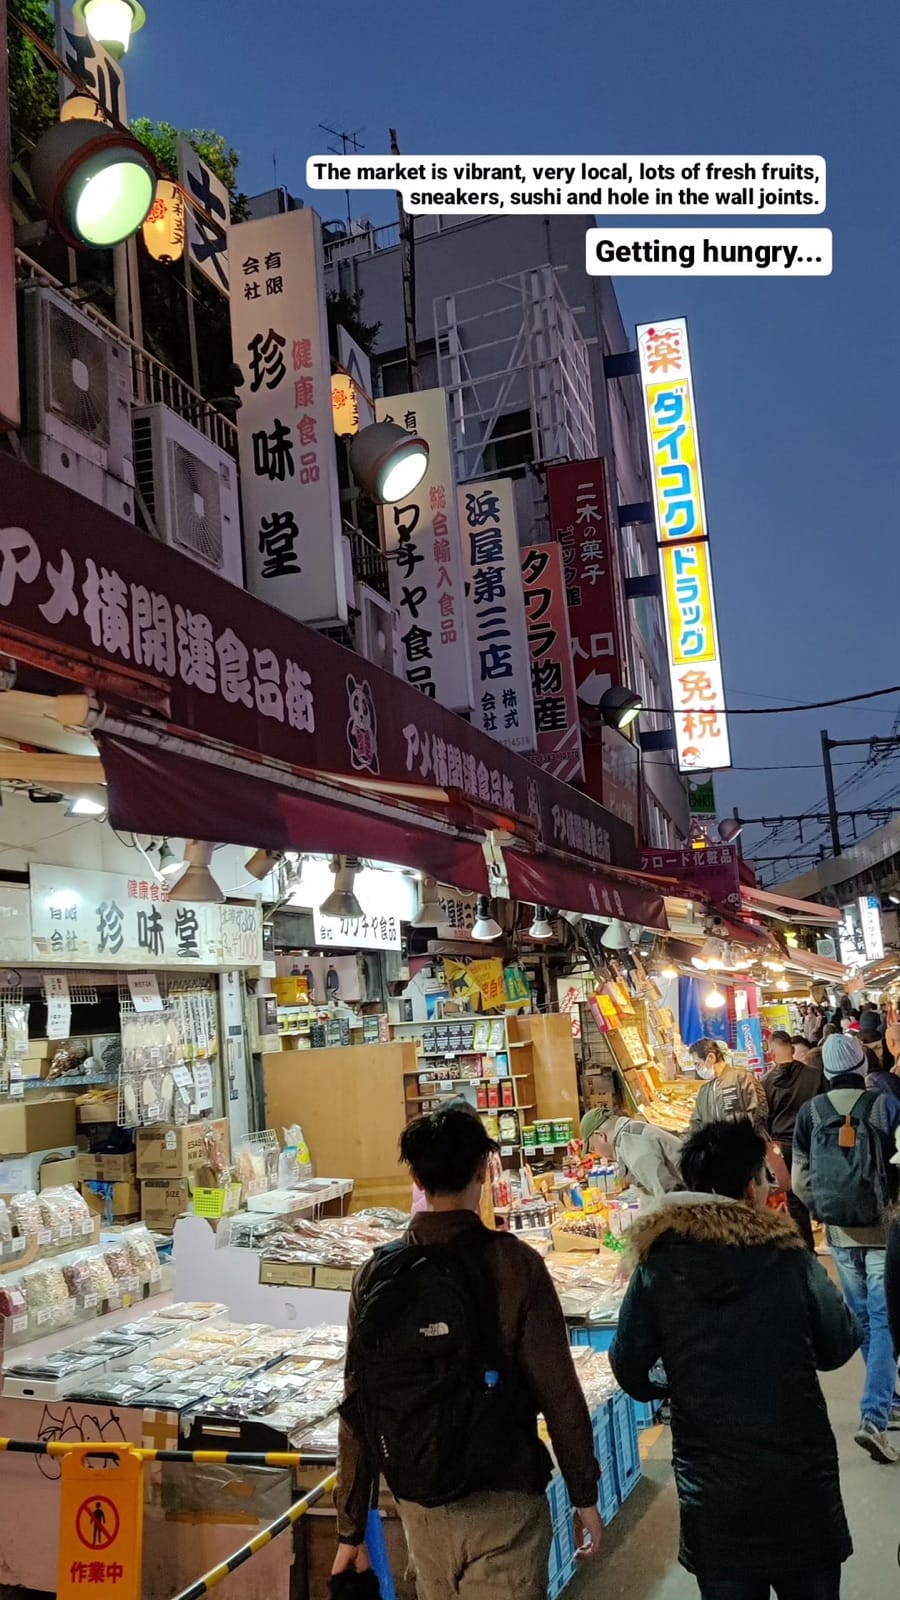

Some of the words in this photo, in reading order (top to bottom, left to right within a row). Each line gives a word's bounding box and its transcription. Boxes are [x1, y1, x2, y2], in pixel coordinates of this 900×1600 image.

[242, 256, 262, 300] 会社
[264, 251, 284, 296] 有限
[646, 330, 683, 373] 薬
[291, 338, 320, 485] 健康食品
[247, 327, 302, 578] 珍味堂
[654, 386, 696, 537] ダイコク
[575, 482, 606, 586] 二木の菓子
[465, 490, 513, 681] 浜屋第三店
[673, 548, 704, 656] ドラッグ
[520, 549, 569, 733] タワラ物産
[571, 632, 614, 660] 入口
[678, 669, 721, 741] 免税
[128, 879, 171, 903] 健康食品
[50, 929, 78, 952] 会社
[96, 900, 201, 958] 珍味堂
[70, 1561, 124, 1584] 作業中
